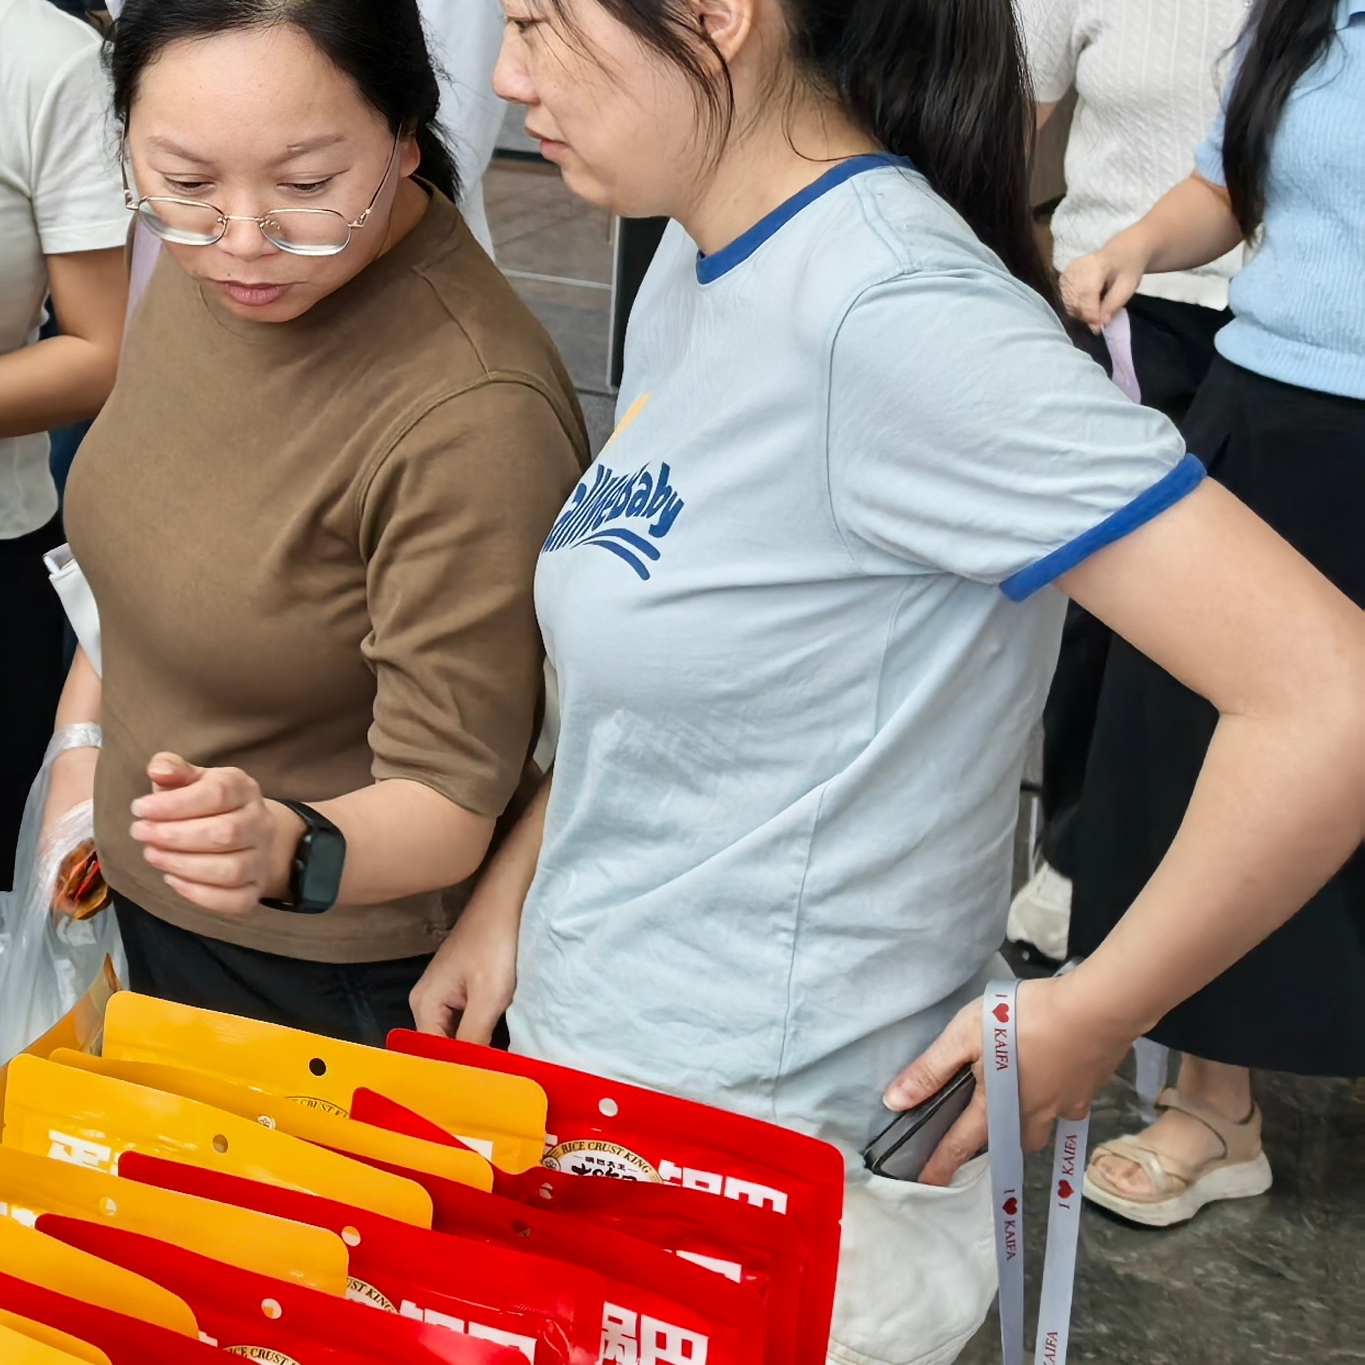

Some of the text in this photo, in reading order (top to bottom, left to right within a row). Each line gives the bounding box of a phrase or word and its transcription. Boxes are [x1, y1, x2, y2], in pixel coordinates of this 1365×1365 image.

[994, 1027, 1009, 1072] KAIFA
[561, 1141, 585, 1154] RICE
[587, 1142, 625, 1156] CRUST
[623, 1152, 653, 1174] KING
[1061, 1134, 1077, 1176] KAIFA
[1004, 1219, 1018, 1262] KAIFA
[250, 1347, 289, 1365] CRUST
